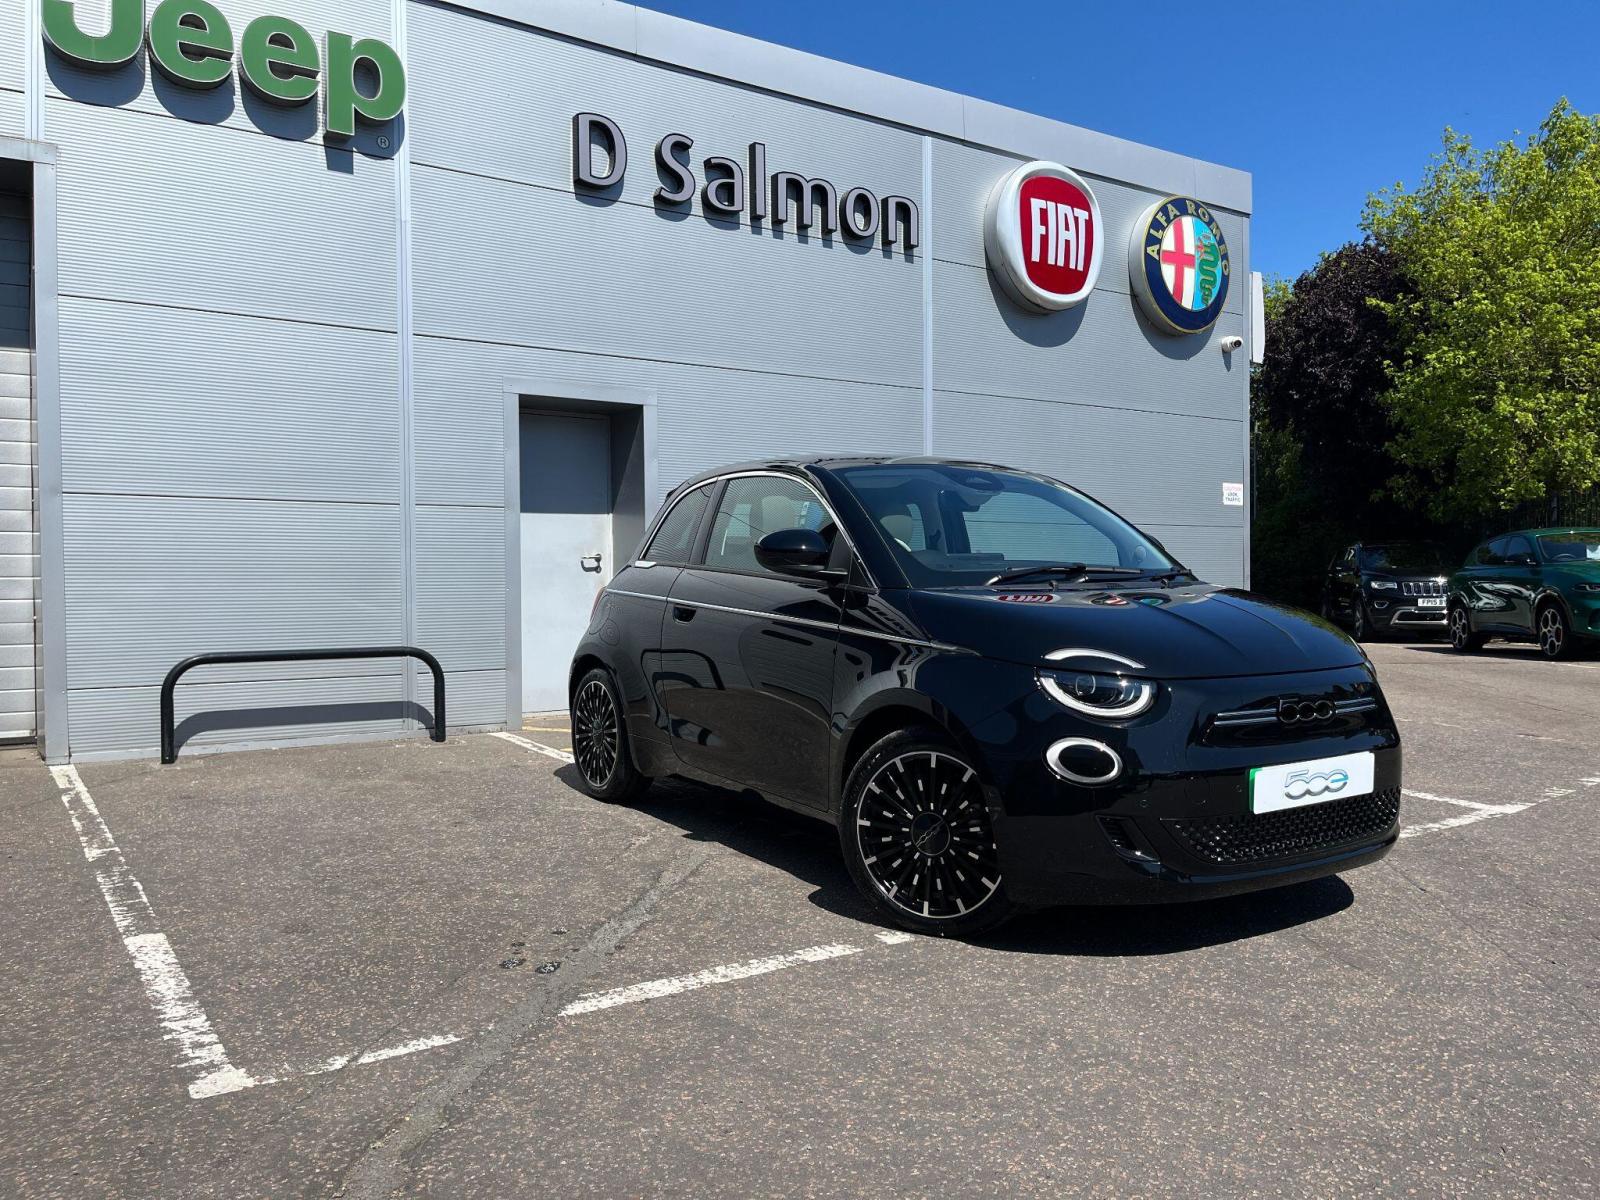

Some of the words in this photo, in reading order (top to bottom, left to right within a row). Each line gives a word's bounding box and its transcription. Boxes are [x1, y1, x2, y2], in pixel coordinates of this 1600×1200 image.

[41, 0, 406, 136] Jeep
[572, 112, 628, 188] D
[653, 133, 920, 250] Salmon
[1030, 197, 1089, 272] FIAT
[1146, 203, 1180, 261] ALFA
[1185, 199, 1230, 276] ROMEO
[1279, 698, 1334, 724] 500
